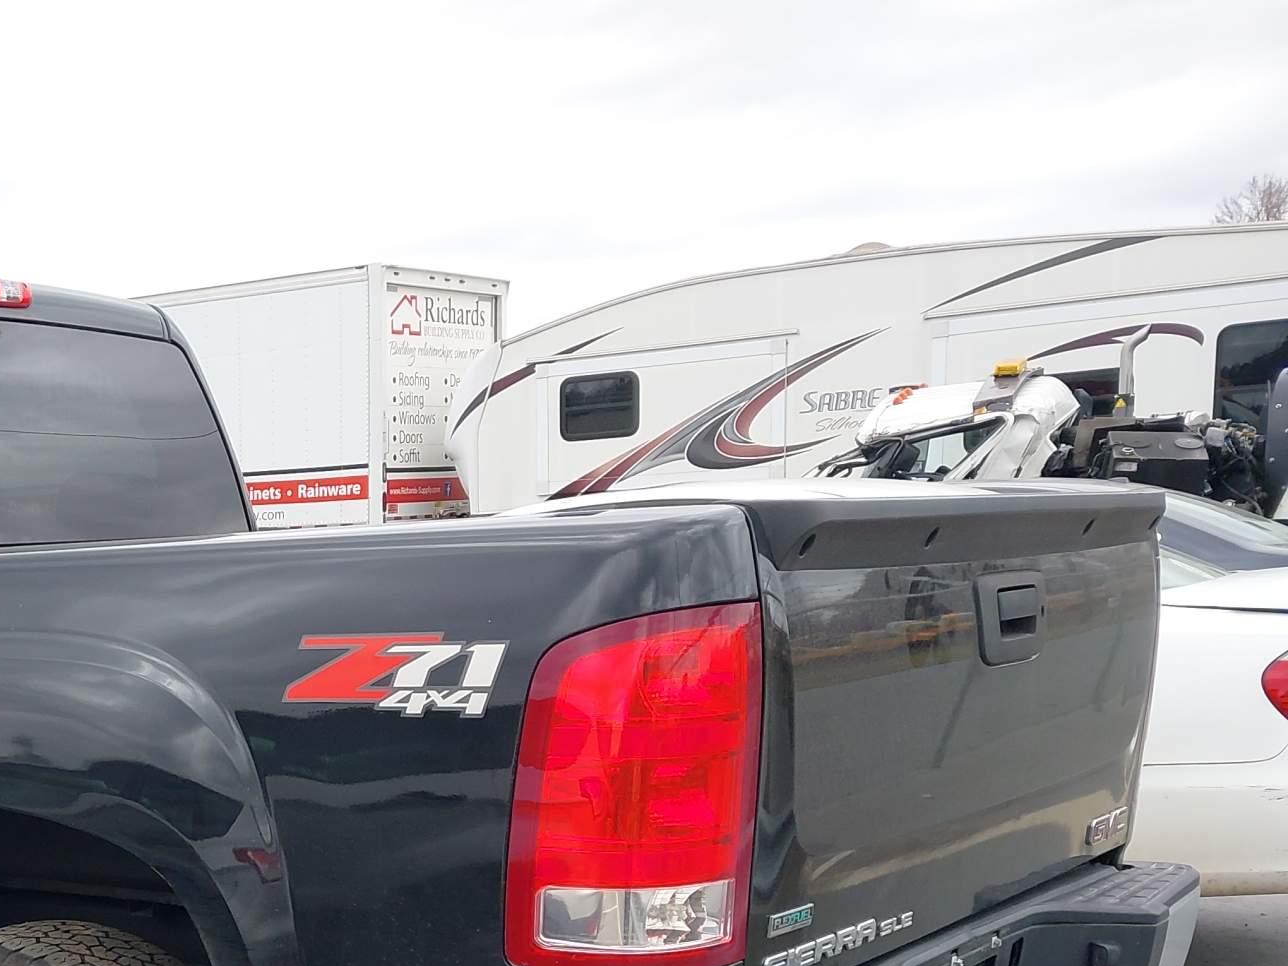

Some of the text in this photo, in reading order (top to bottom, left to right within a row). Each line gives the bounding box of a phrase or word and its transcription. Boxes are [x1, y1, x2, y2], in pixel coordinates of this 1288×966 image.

[424, 296, 485, 326] Richards
[424, 326, 454, 338] BUILDING
[455, 328, 474, 340] SUPPLY
[388, 339, 417, 367] Building
[469, 347, 485, 360] 197
[398, 372, 430, 390] Roofing
[398, 391, 424, 409] Siding
[799, 387, 883, 414] SABRE
[398, 410, 436, 425] Windows
[398, 430, 423, 444] Doors
[398, 447, 421, 463] Soffit
[249, 482, 361, 501] inets Rainware
[282, 631, 510, 703] Z71
[880, 911, 914, 937] SLE
